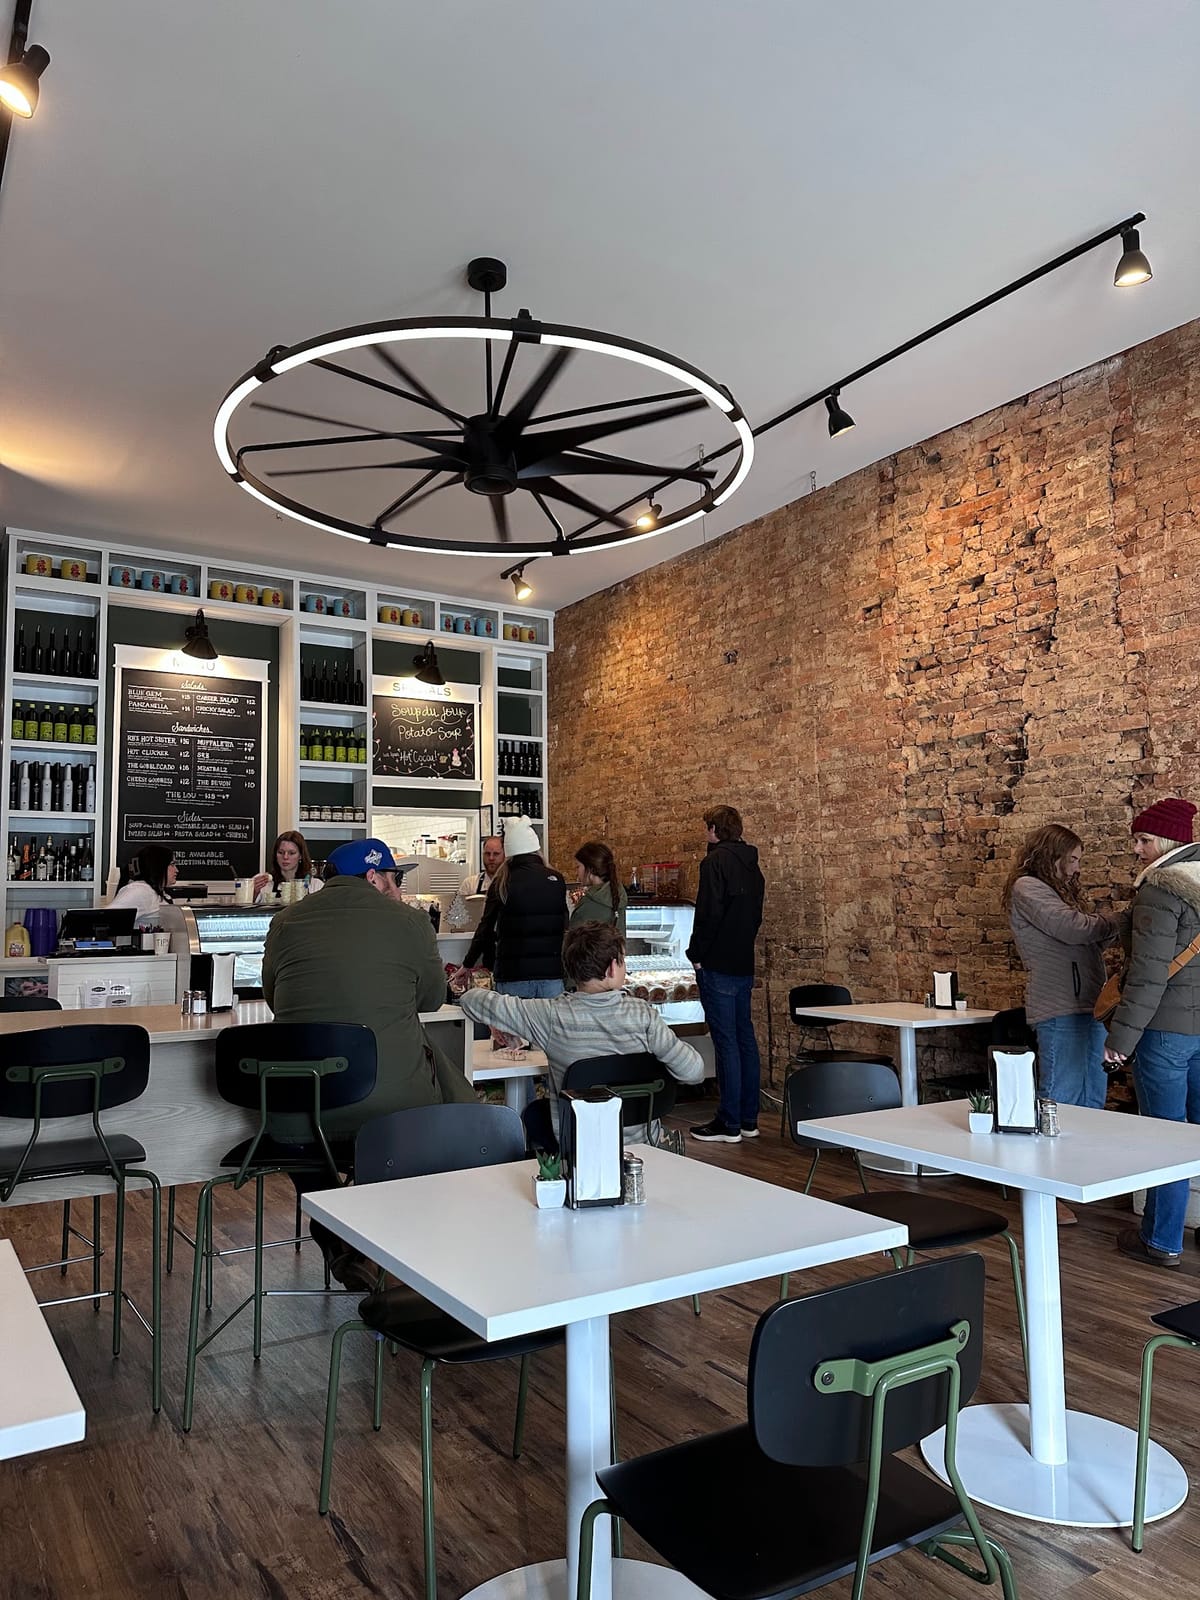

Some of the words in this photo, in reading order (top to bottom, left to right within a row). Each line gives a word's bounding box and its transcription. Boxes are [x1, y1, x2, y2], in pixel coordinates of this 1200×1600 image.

[219, 696, 239, 704] SALAD
[391, 703, 421, 721] Soup
[421, 706, 439, 718] du
[397, 725, 437, 741] Potato
[437, 726, 463, 741] Soup
[140, 736, 154, 744] HOT
[165, 791, 182, 799] THE
[177, 810, 203, 823] Sides
